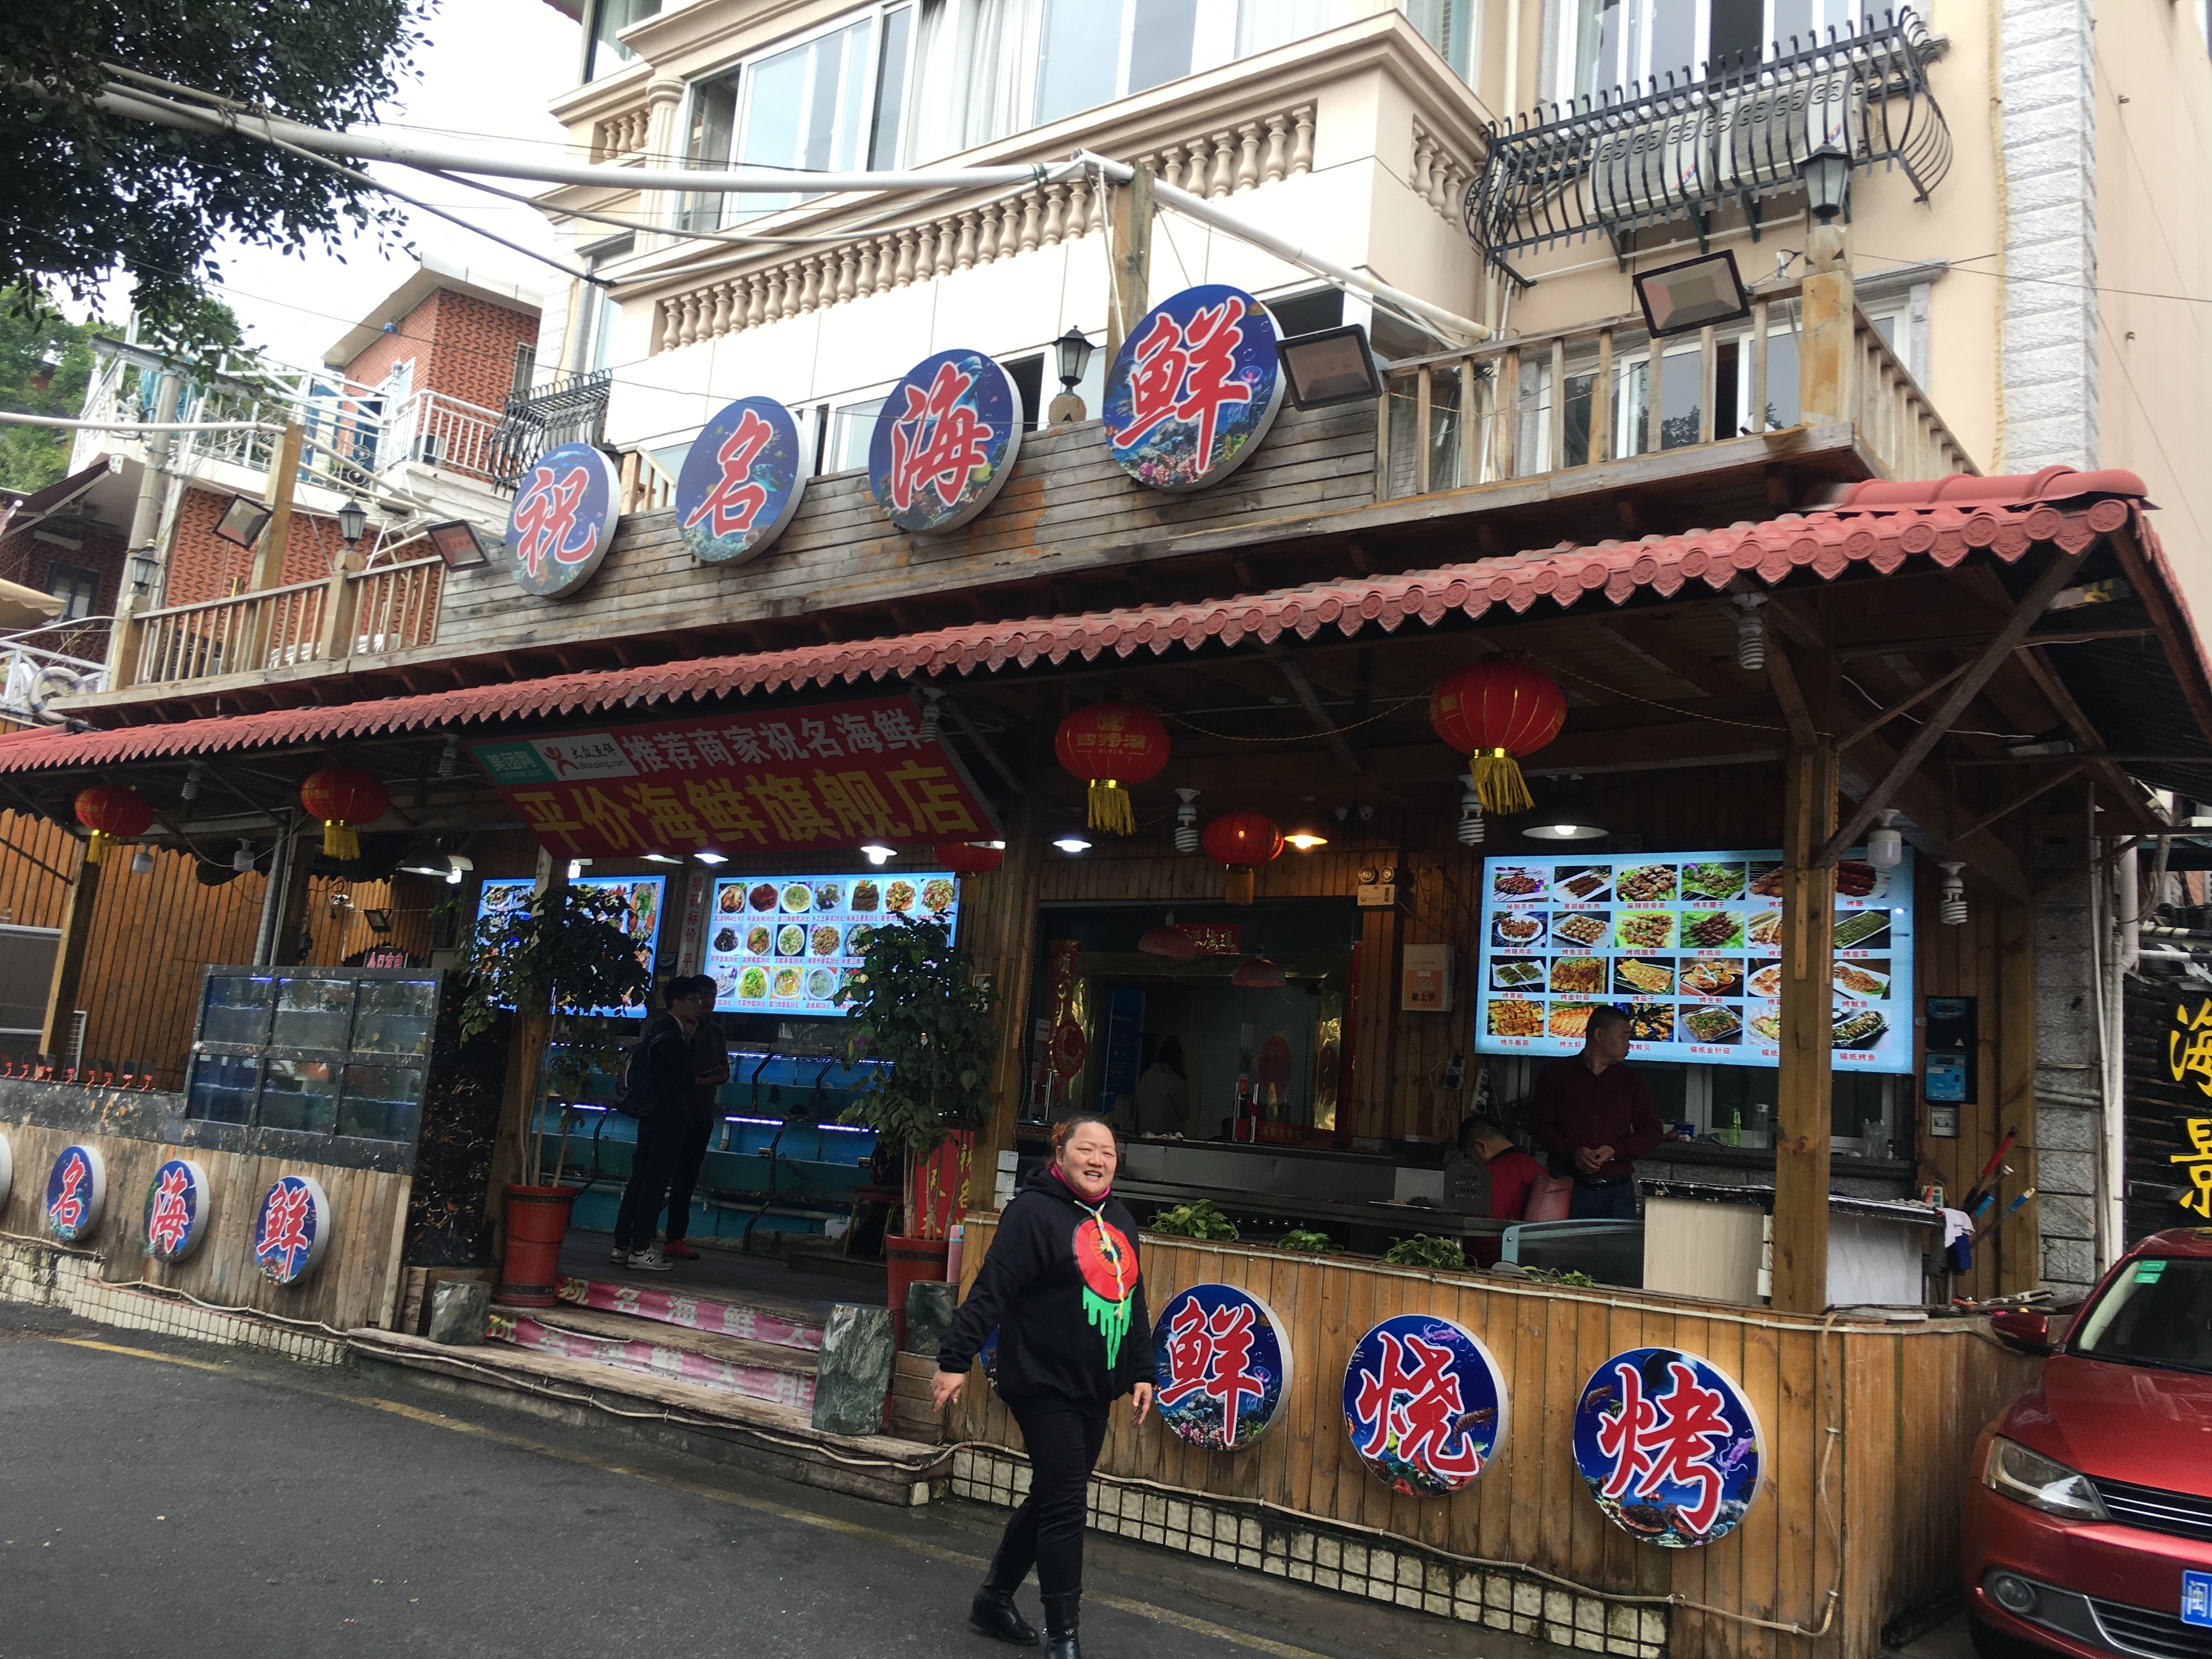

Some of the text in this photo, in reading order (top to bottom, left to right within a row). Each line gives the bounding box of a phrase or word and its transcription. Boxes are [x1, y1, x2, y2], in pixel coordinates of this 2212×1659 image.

[513, 297, 1254, 578] 祝名海鲜
[486, 751, 537, 771] 美团网
[571, 742, 616, 759] 大众点评
[621, 708, 922, 774] 推荐商家祝名海鲜
[514, 759, 979, 853] 平价海鲜旗舰店
[49, 1152, 309, 1282] 名海鲜
[1158, 1295, 1733, 1535] 鲜烧烤
[2187, 1580, 2212, 1618] 闽
